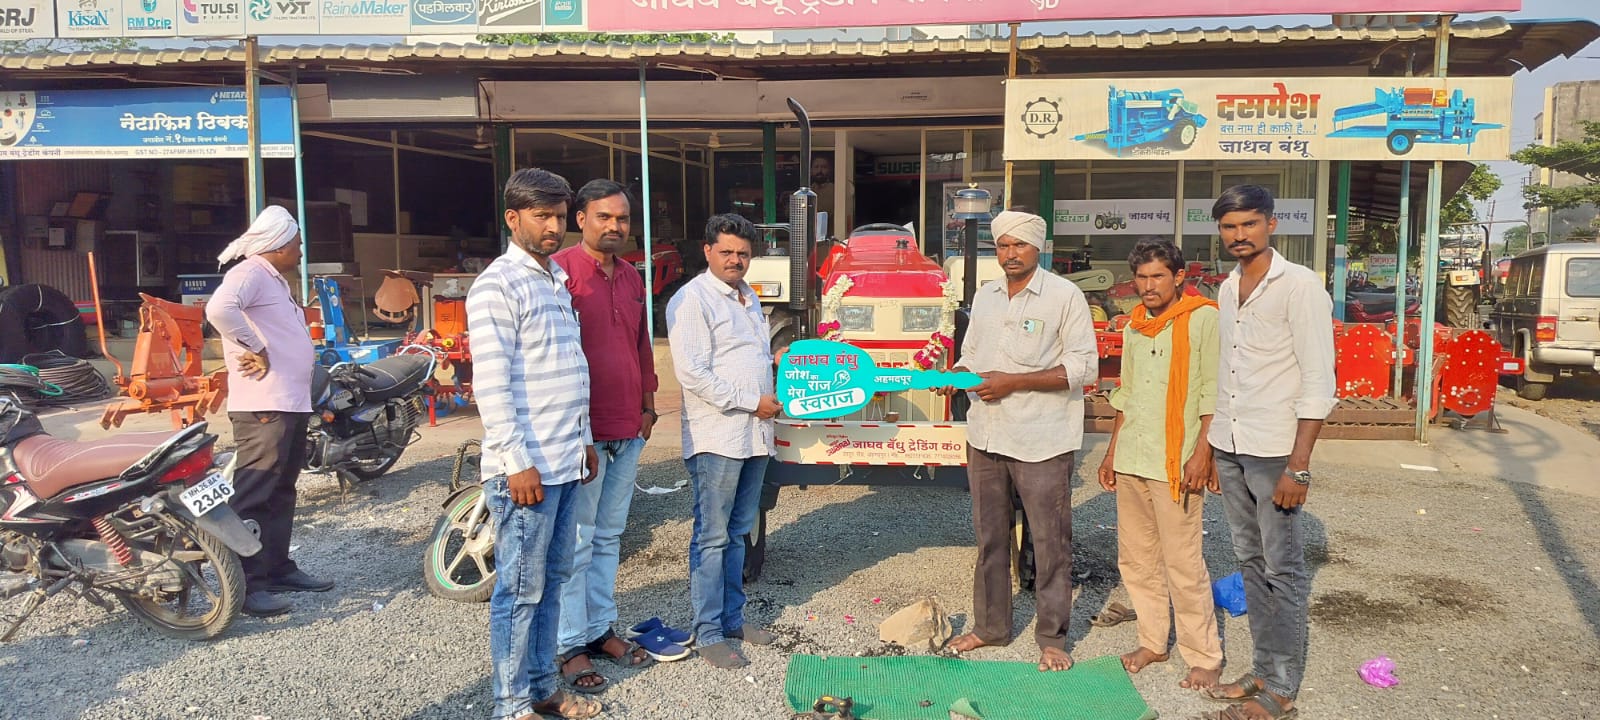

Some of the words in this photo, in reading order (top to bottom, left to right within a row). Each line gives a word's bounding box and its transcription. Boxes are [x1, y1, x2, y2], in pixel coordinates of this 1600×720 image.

[200, 3, 239, 15] TULSI
[276, 1, 311, 15] VST
[418, 1, 475, 15] पडगिलवार
[127, 17, 145, 28] RM
[147, 17, 172, 30] Drip
[1215, 82, 1321, 121] दसमेश
[1029, 112, 1056, 124] D.R.
[1220, 124, 1234, 134] बस
[1238, 124, 1254, 133] नाम
[1257, 121, 1267, 135] ही
[1269, 121, 1293, 134] काफी
[1218, 140, 1273, 154] जाधव
[1278, 135, 1315, 158] बंधू
[788, 354, 830, 366] जाधव
[835, 350, 859, 371] बंधु
[784, 367, 810, 380] जोश
[873, 374, 913, 386] अहमदपूर
[787, 385, 807, 399] मेरा
[807, 379, 832, 392] राज
[799, 390, 854, 412] स्वराज
[192, 483, 232, 514] 2346
